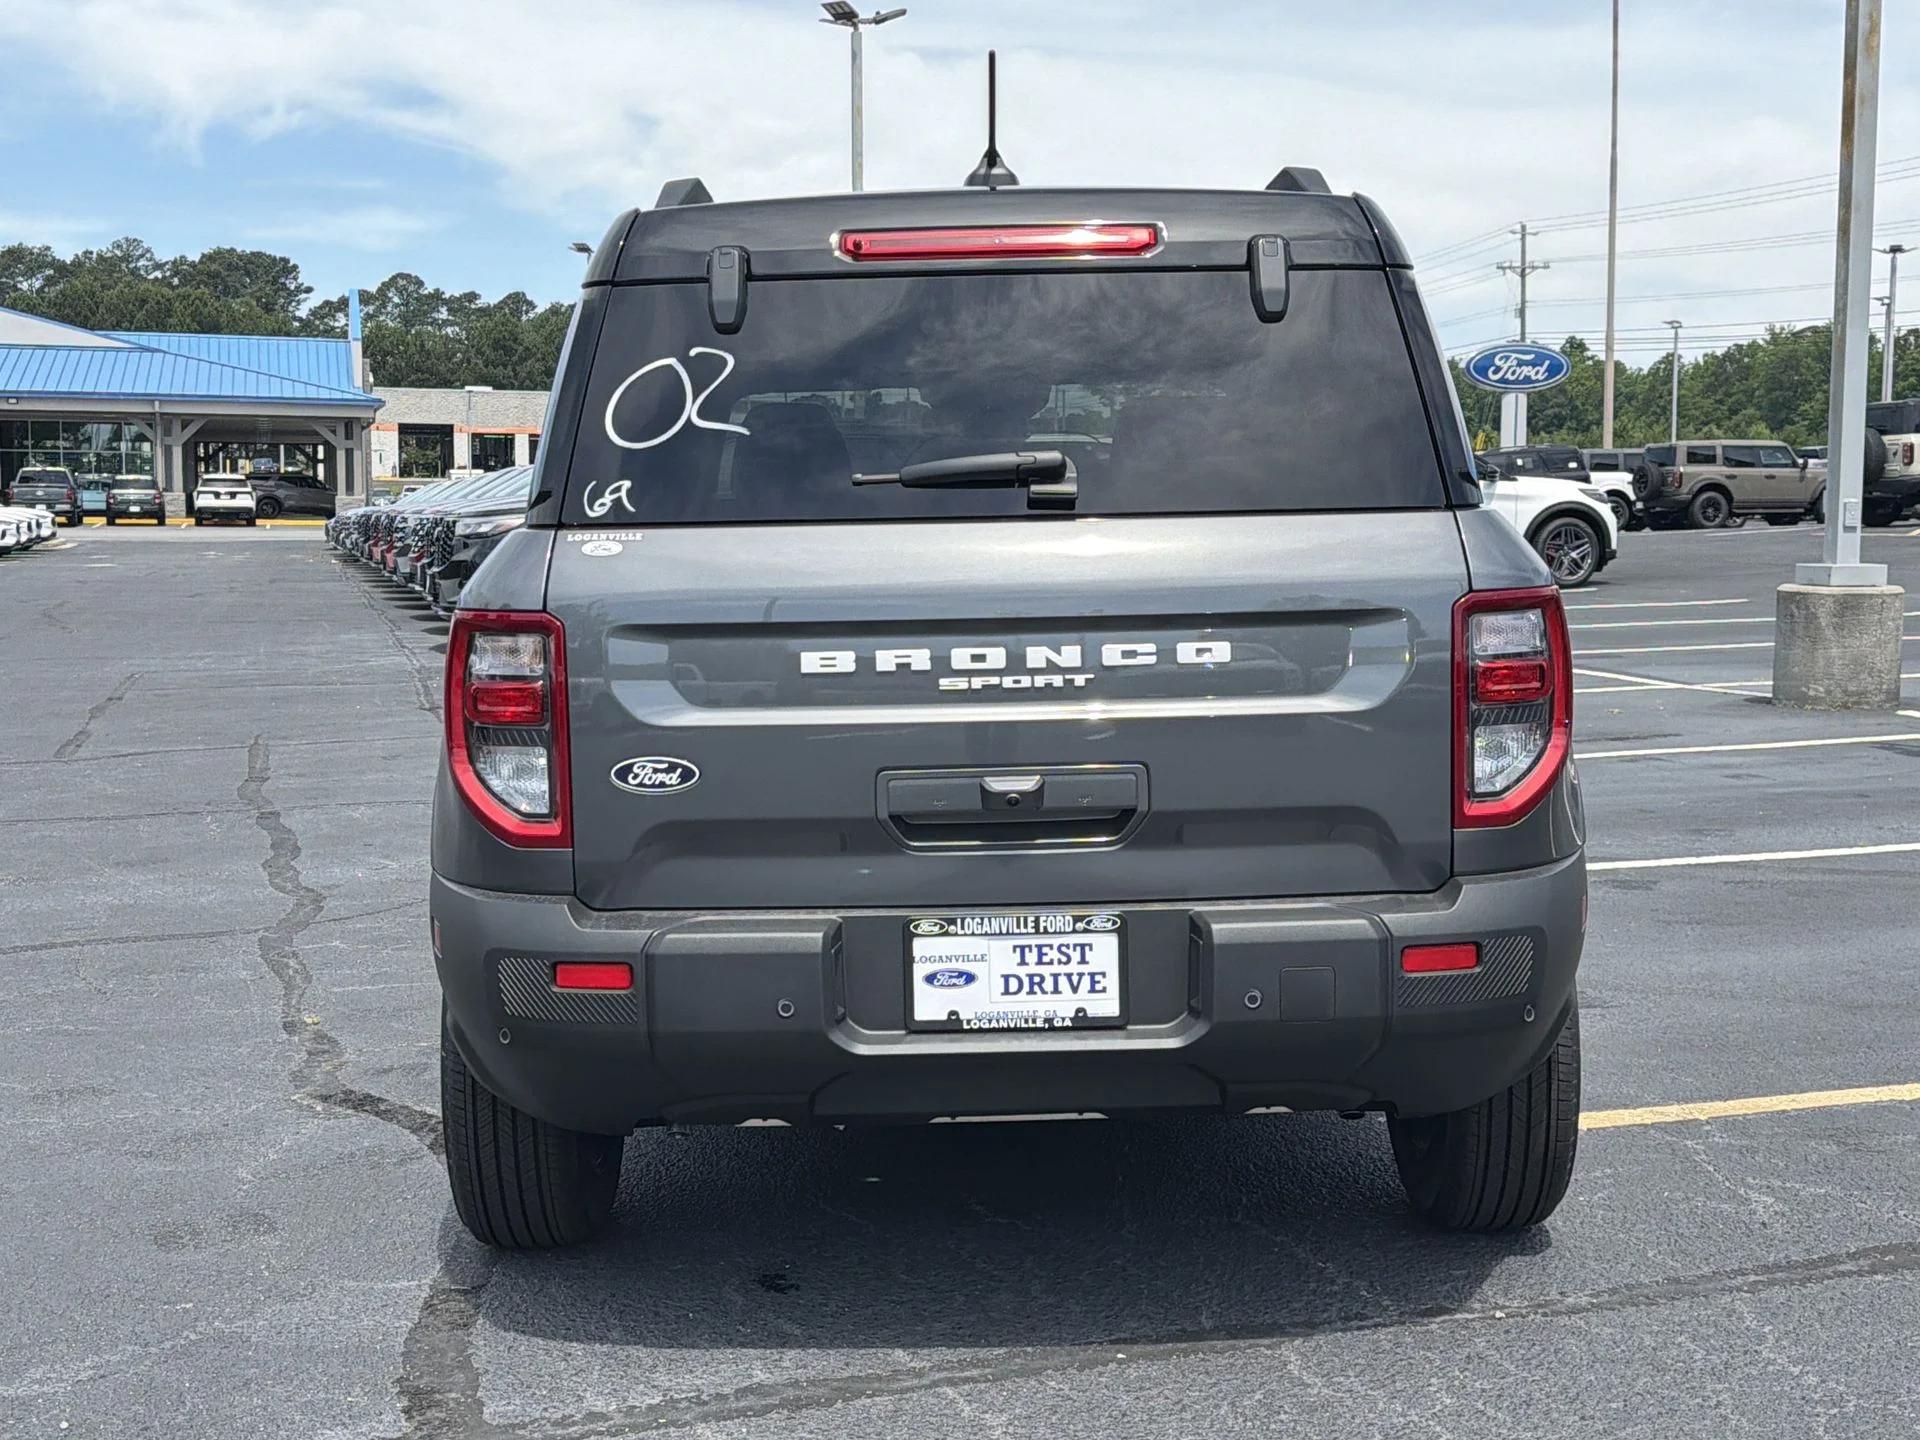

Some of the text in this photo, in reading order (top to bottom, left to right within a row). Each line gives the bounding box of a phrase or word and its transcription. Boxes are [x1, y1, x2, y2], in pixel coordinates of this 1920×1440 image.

[1487, 352, 1551, 381] Ford
[567, 532, 643, 542] LOGANVILLE
[800, 641, 1232, 674] BRONCO
[938, 673, 1095, 691] SPORT
[627, 761, 682, 786] Ford
[956, 915, 1074, 935] LOGANVILLE FORD
[1012, 942, 1094, 967] TEST
[933, 971, 968, 986] Ford
[1000, 971, 1108, 996] DRIVE
[962, 1017, 1073, 1029] LOGANVILLE, GA
